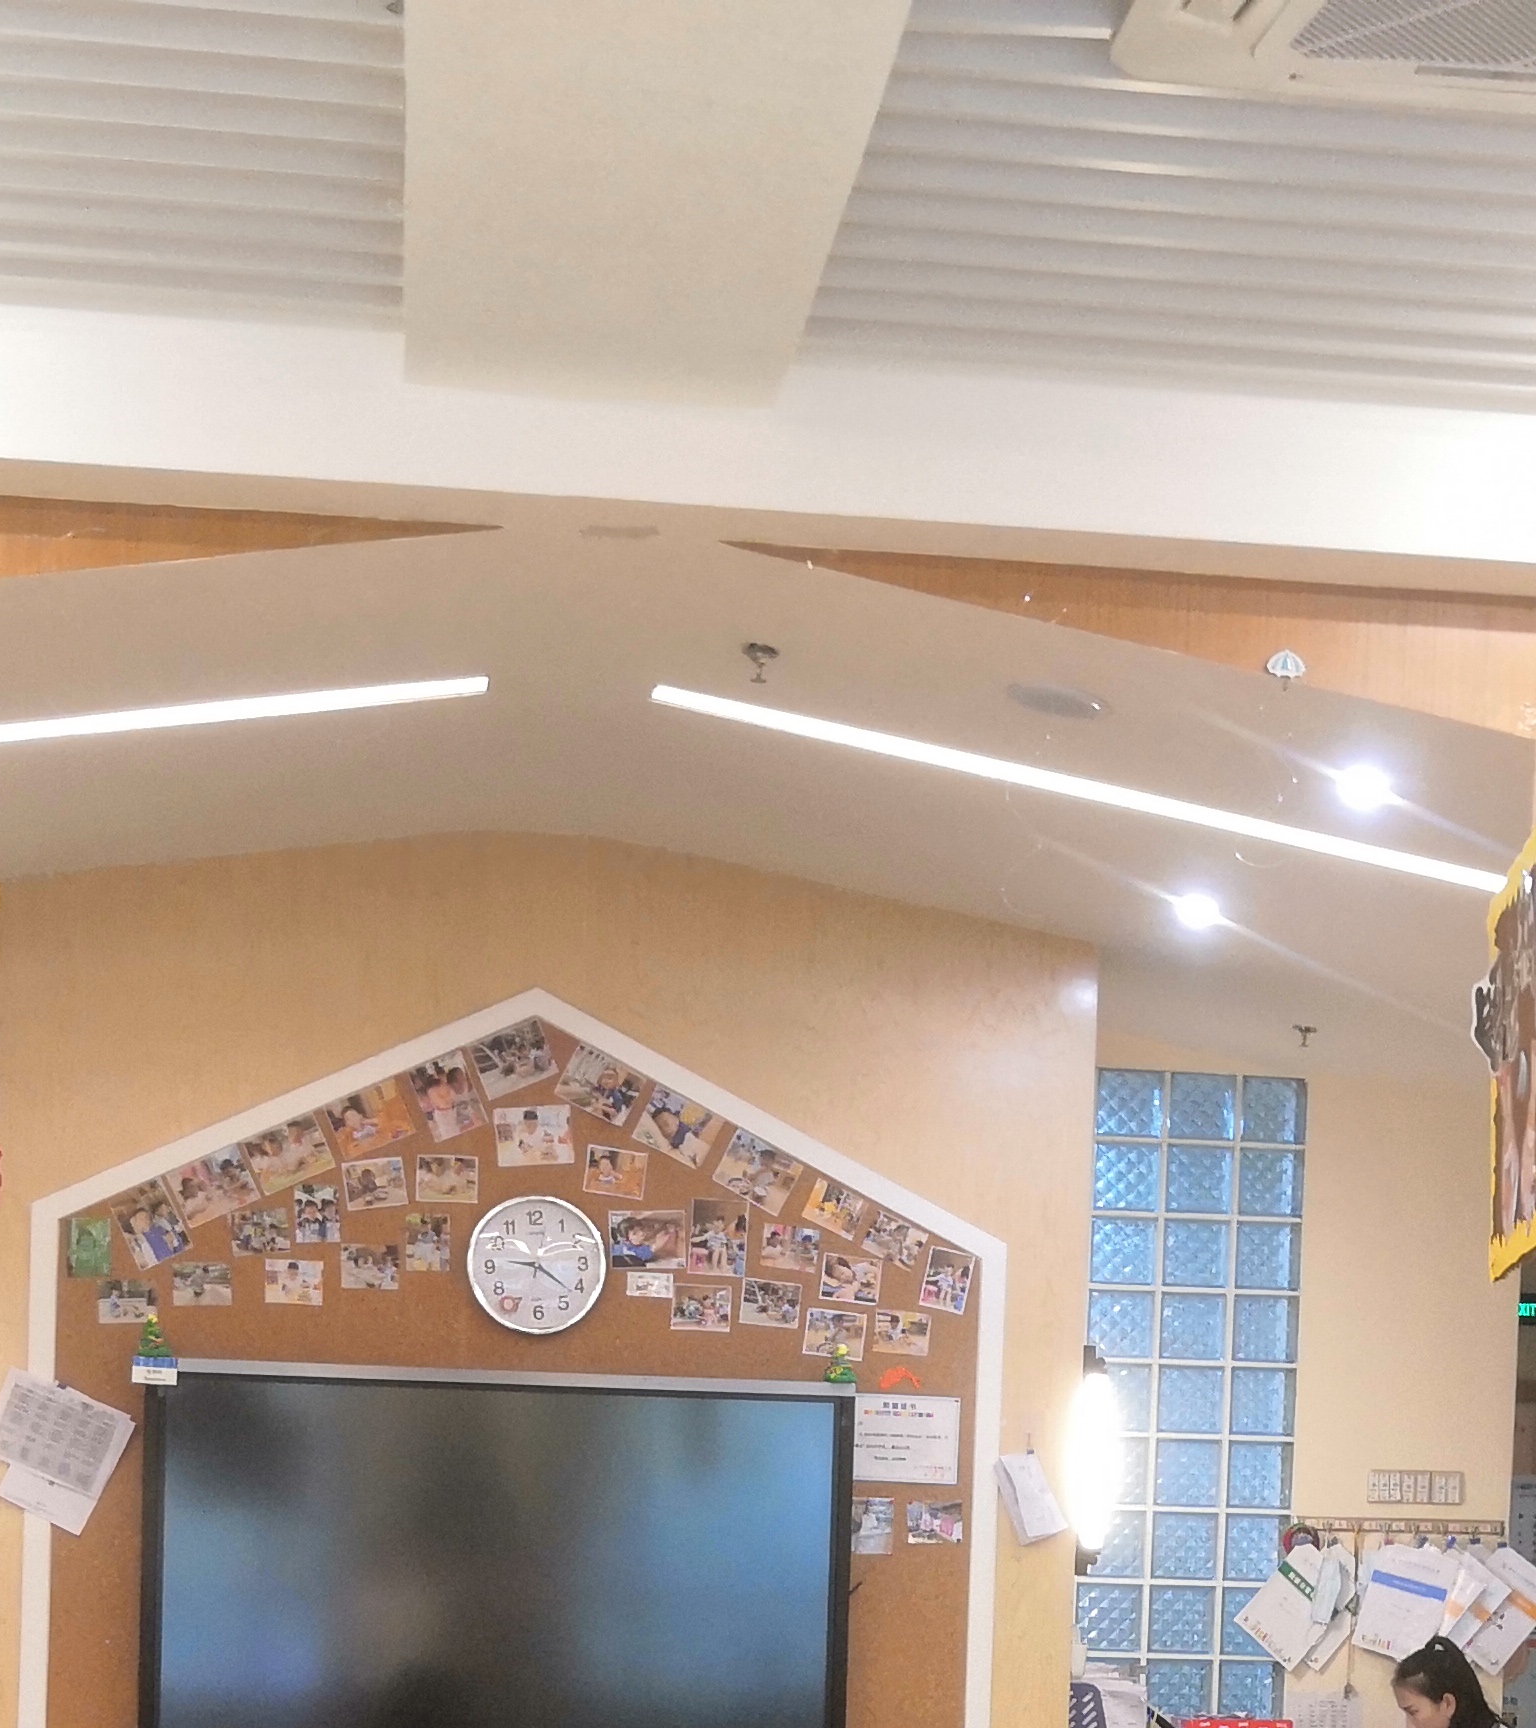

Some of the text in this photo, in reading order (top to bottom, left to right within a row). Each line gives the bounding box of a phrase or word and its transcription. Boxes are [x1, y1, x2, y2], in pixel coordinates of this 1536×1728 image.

[526, 1210, 543, 1226] 12
[558, 1218, 565, 1233] 1
[503, 1219, 516, 1235] 11
[484, 1259, 496, 1275] 9
[577, 1256, 589, 1272] 3
[493, 1280, 505, 1296] 8
[574, 1278, 584, 1294] 4
[558, 1295, 569, 1311] 5
[532, 1305, 545, 1321] 6
